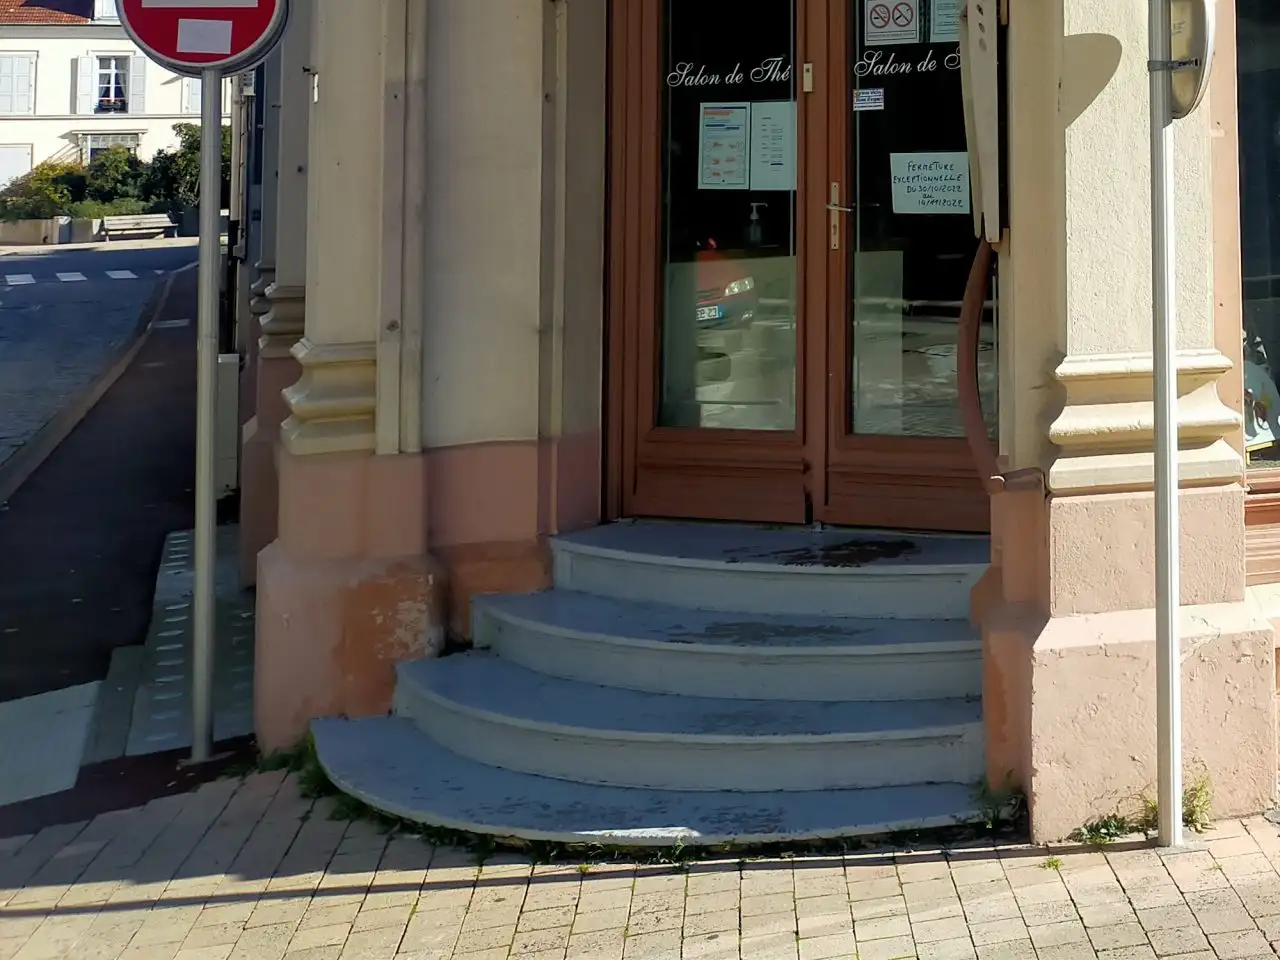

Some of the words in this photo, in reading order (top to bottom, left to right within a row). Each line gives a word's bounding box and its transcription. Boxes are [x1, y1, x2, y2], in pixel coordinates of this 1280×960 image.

[666, 62, 721, 88] Salon
[724, 62, 744, 85] de
[749, 56, 792, 83] Thé
[853, 49, 913, 77] Salon
[916, 49, 938, 73] de
